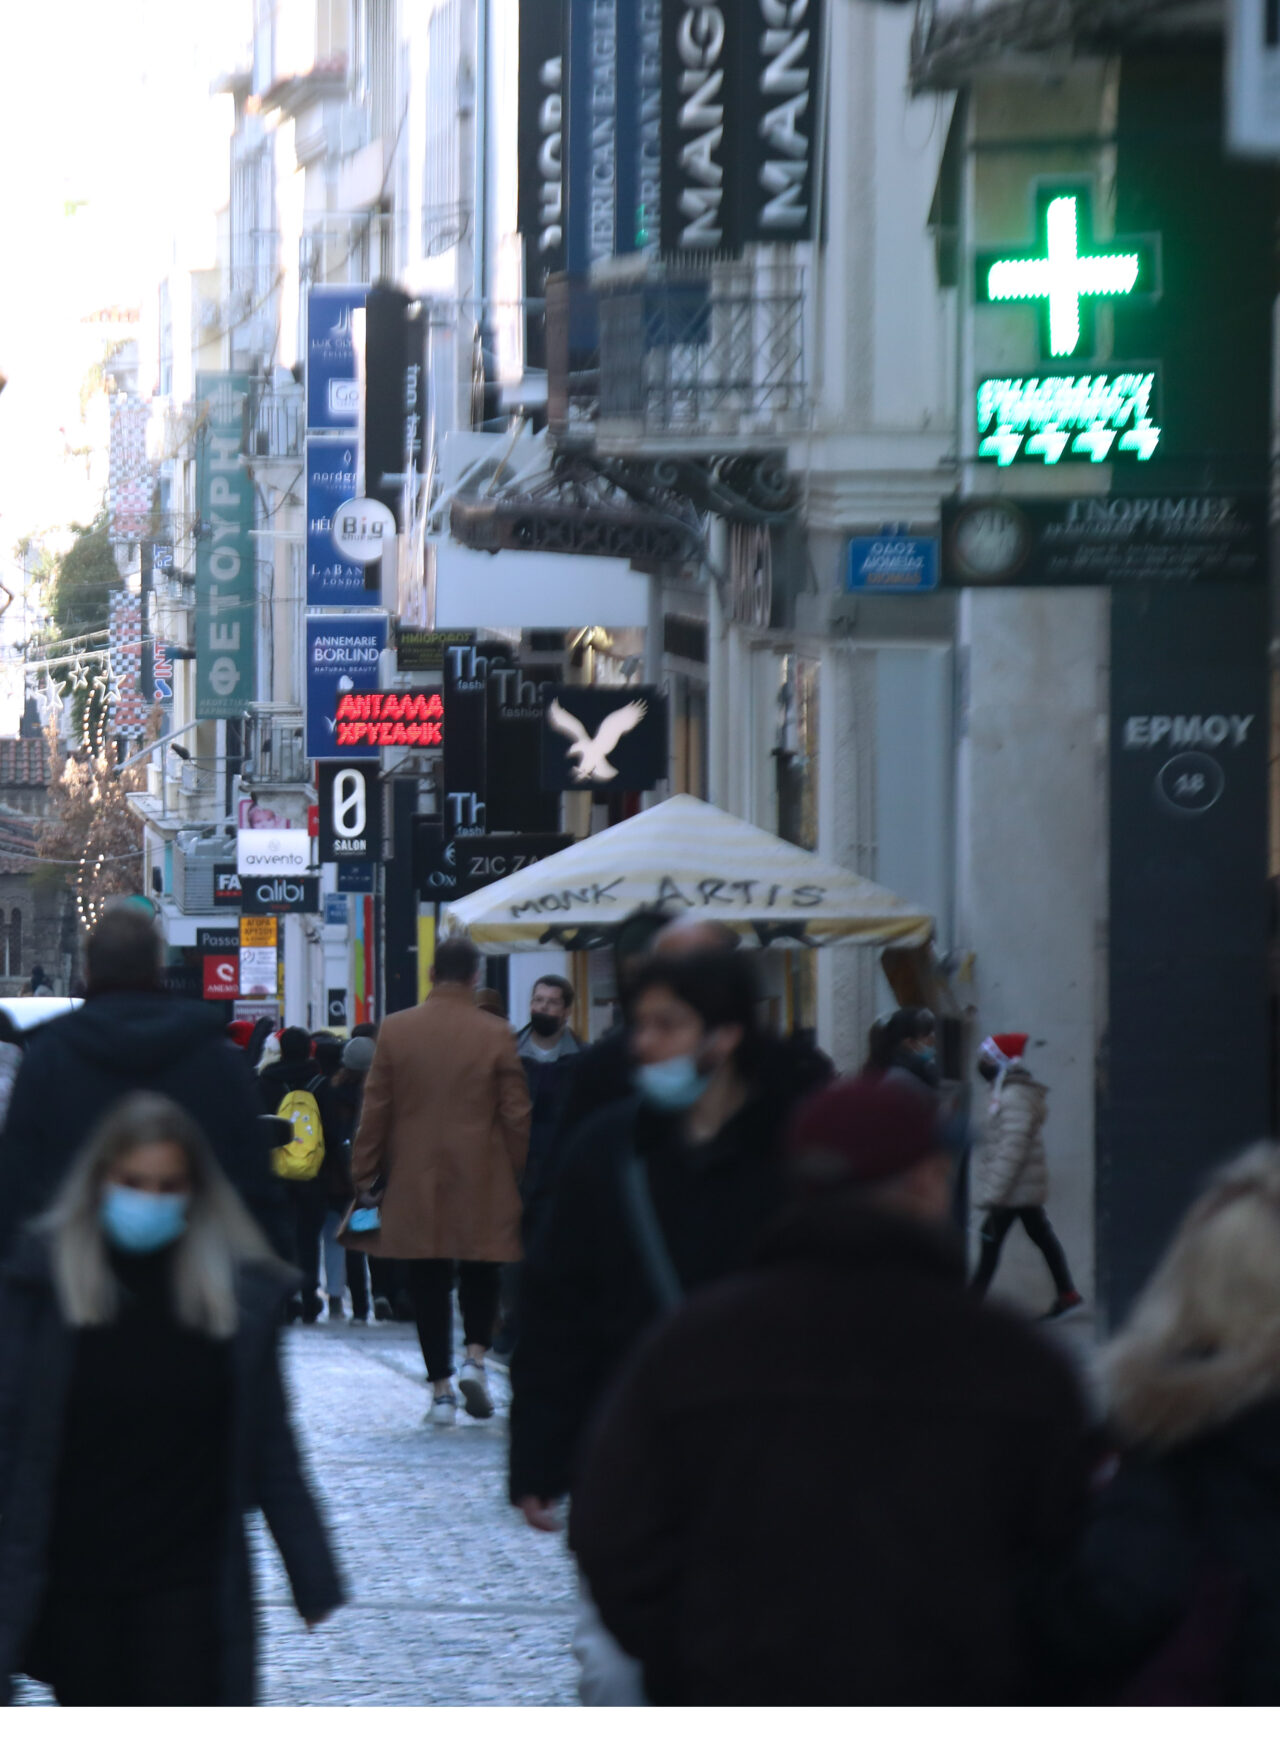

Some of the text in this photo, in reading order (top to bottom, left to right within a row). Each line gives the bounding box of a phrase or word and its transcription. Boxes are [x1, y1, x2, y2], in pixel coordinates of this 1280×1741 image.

[343, 517, 383, 538] Big
[315, 636, 377, 646] ANNEMARIE
[1123, 715, 1256, 750] ΕΡΜΟΥ
[334, 840, 367, 850] SALON
[246, 853, 304, 865] avvento
[256, 879, 305, 902] alibi
[511, 874, 827, 919] MONK ARTIS
